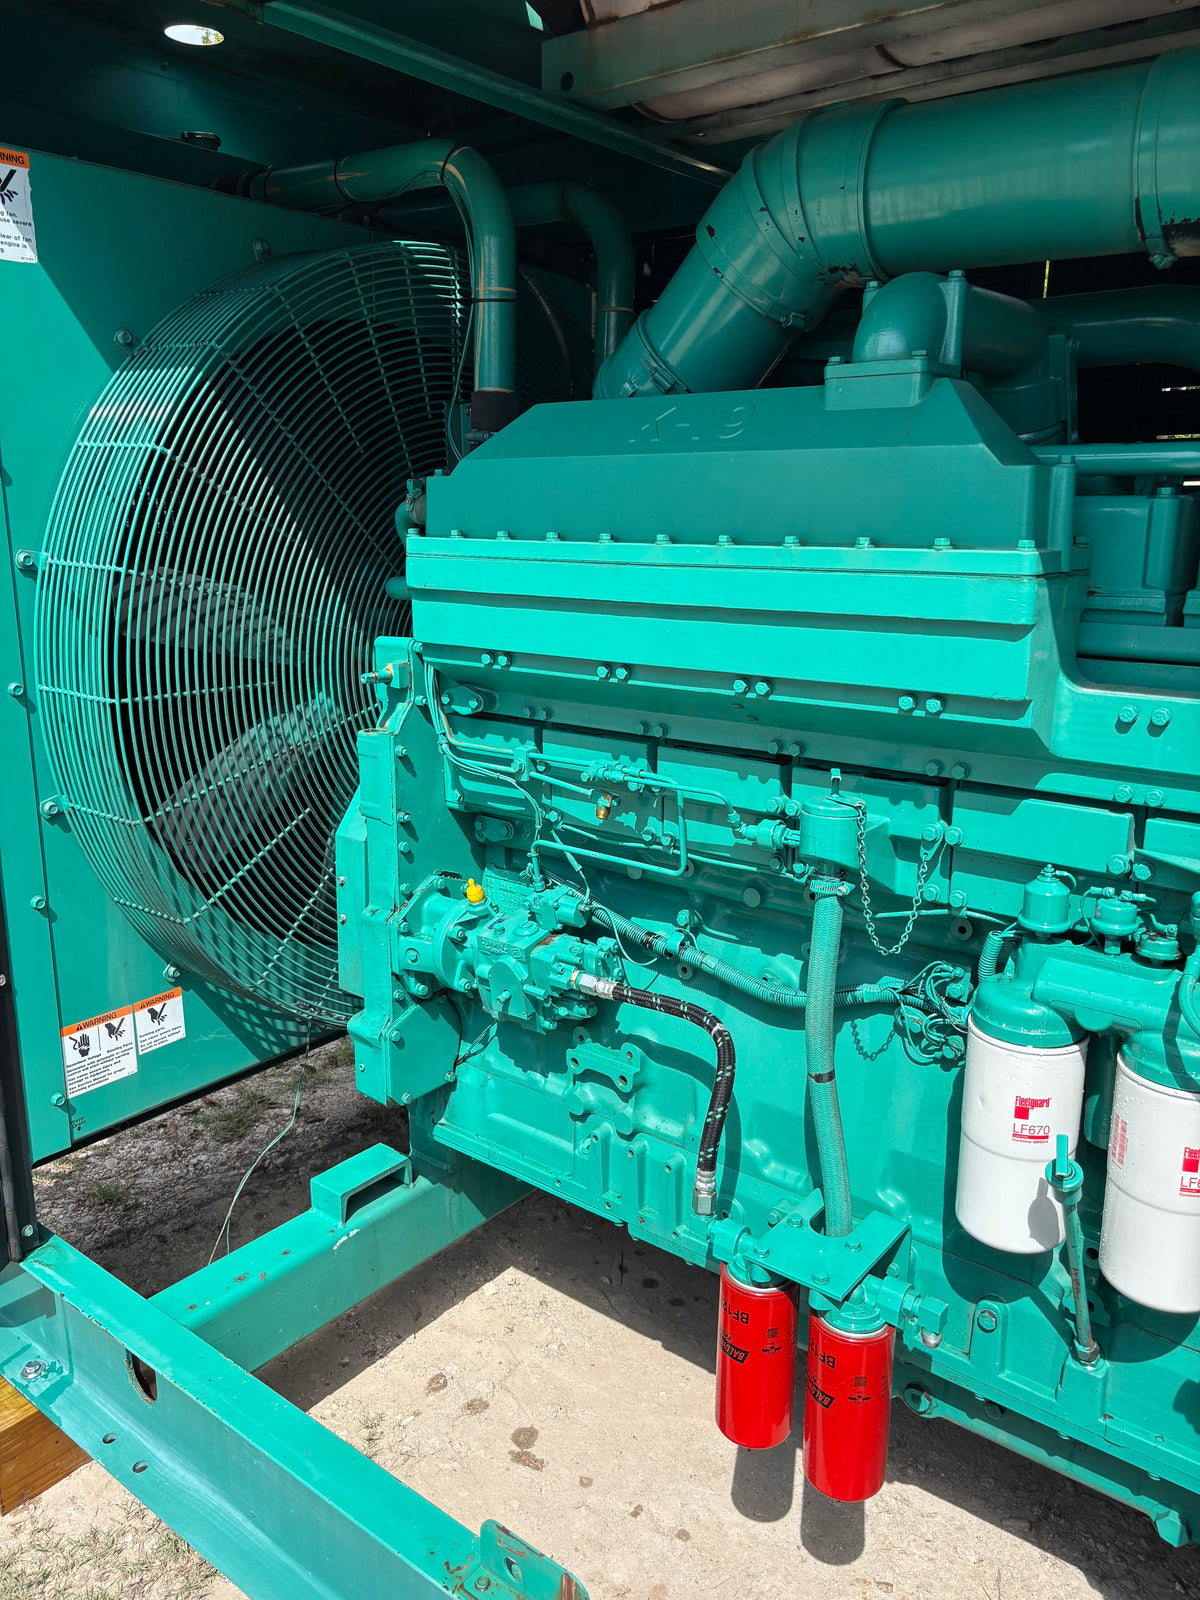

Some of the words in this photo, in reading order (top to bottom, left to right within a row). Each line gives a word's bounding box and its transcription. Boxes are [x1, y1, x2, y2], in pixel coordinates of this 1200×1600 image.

[13, 219, 32, 227] severe
[628, 401, 758, 442] K-19
[145, 991, 175, 1007] WARNING
[82, 1011, 117, 1029] WARNING
[66, 1059, 86, 1068] Hazardous
[88, 1053, 101, 1061] Voltage
[67, 1064, 86, 1073] Generator
[97, 1054, 114, 1063] automatic
[1013, 1123, 1050, 1135] LF670
